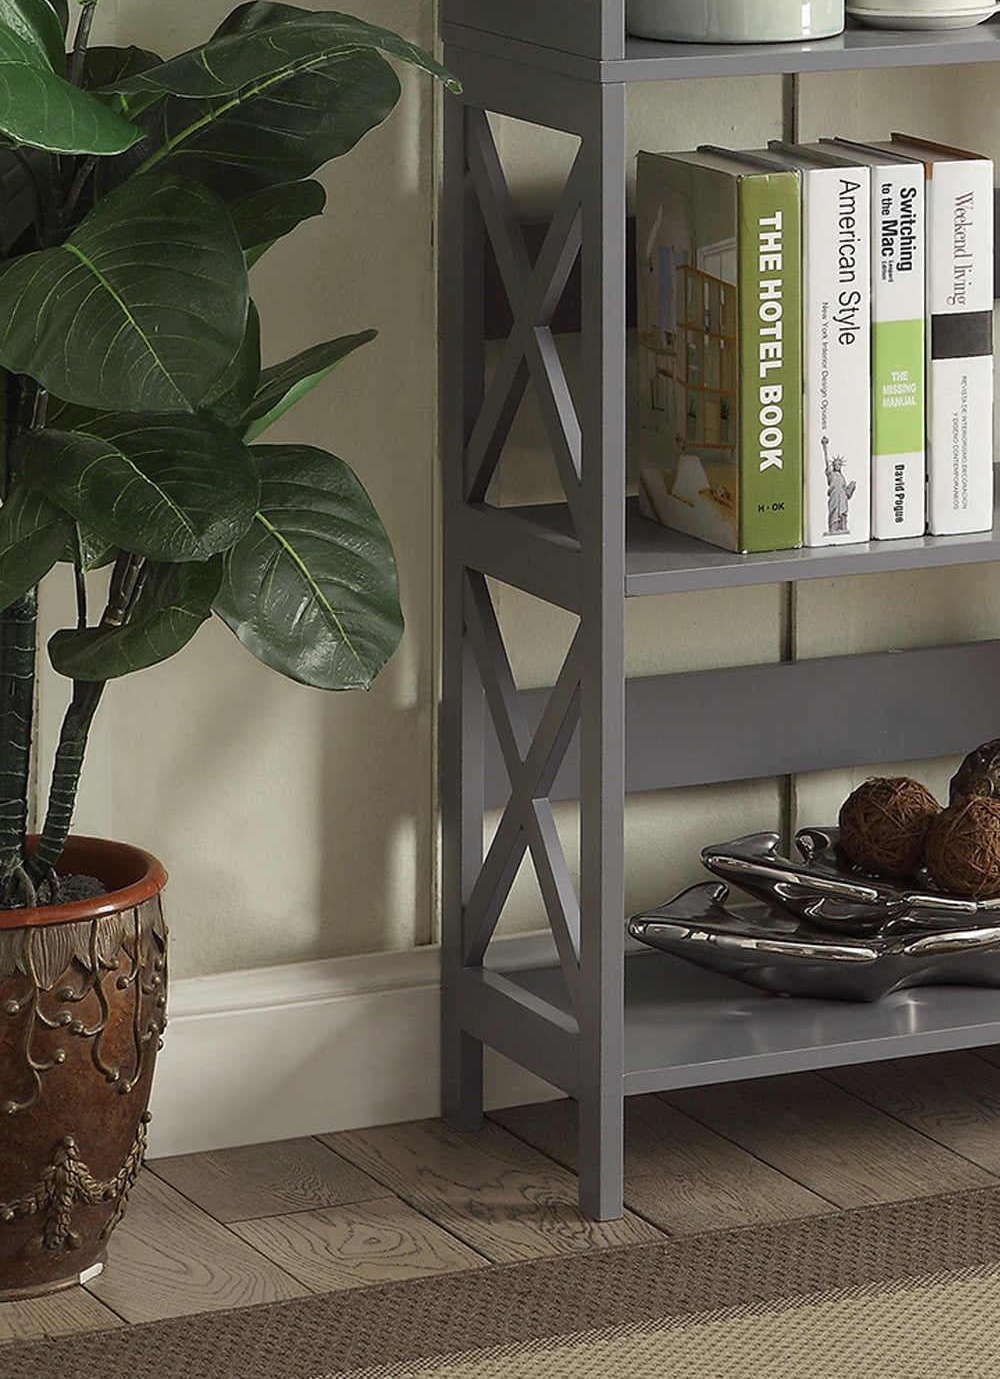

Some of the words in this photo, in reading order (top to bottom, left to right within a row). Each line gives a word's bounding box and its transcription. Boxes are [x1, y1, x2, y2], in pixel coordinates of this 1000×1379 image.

[881, 183, 893, 194] to
[881, 197, 893, 216] the
[758, 210, 783, 272] THE
[838, 179, 862, 283] American
[881, 220, 898, 257] Mac
[896, 187, 917, 271] Switching
[953, 192, 974, 259] Weekend
[946, 265, 973, 305] living
[821, 302, 829, 320] New
[832, 291, 861, 345] Style
[758, 279, 784, 378] HOTEL
[820, 371, 829, 398] Design
[882, 383, 917, 395] MISSING
[891, 371, 909, 381] THE
[883, 396, 918, 407] MANUAL
[759, 384, 784, 472] BOOK
[894, 464, 905, 491] David
[893, 492, 906, 524] Pogue
